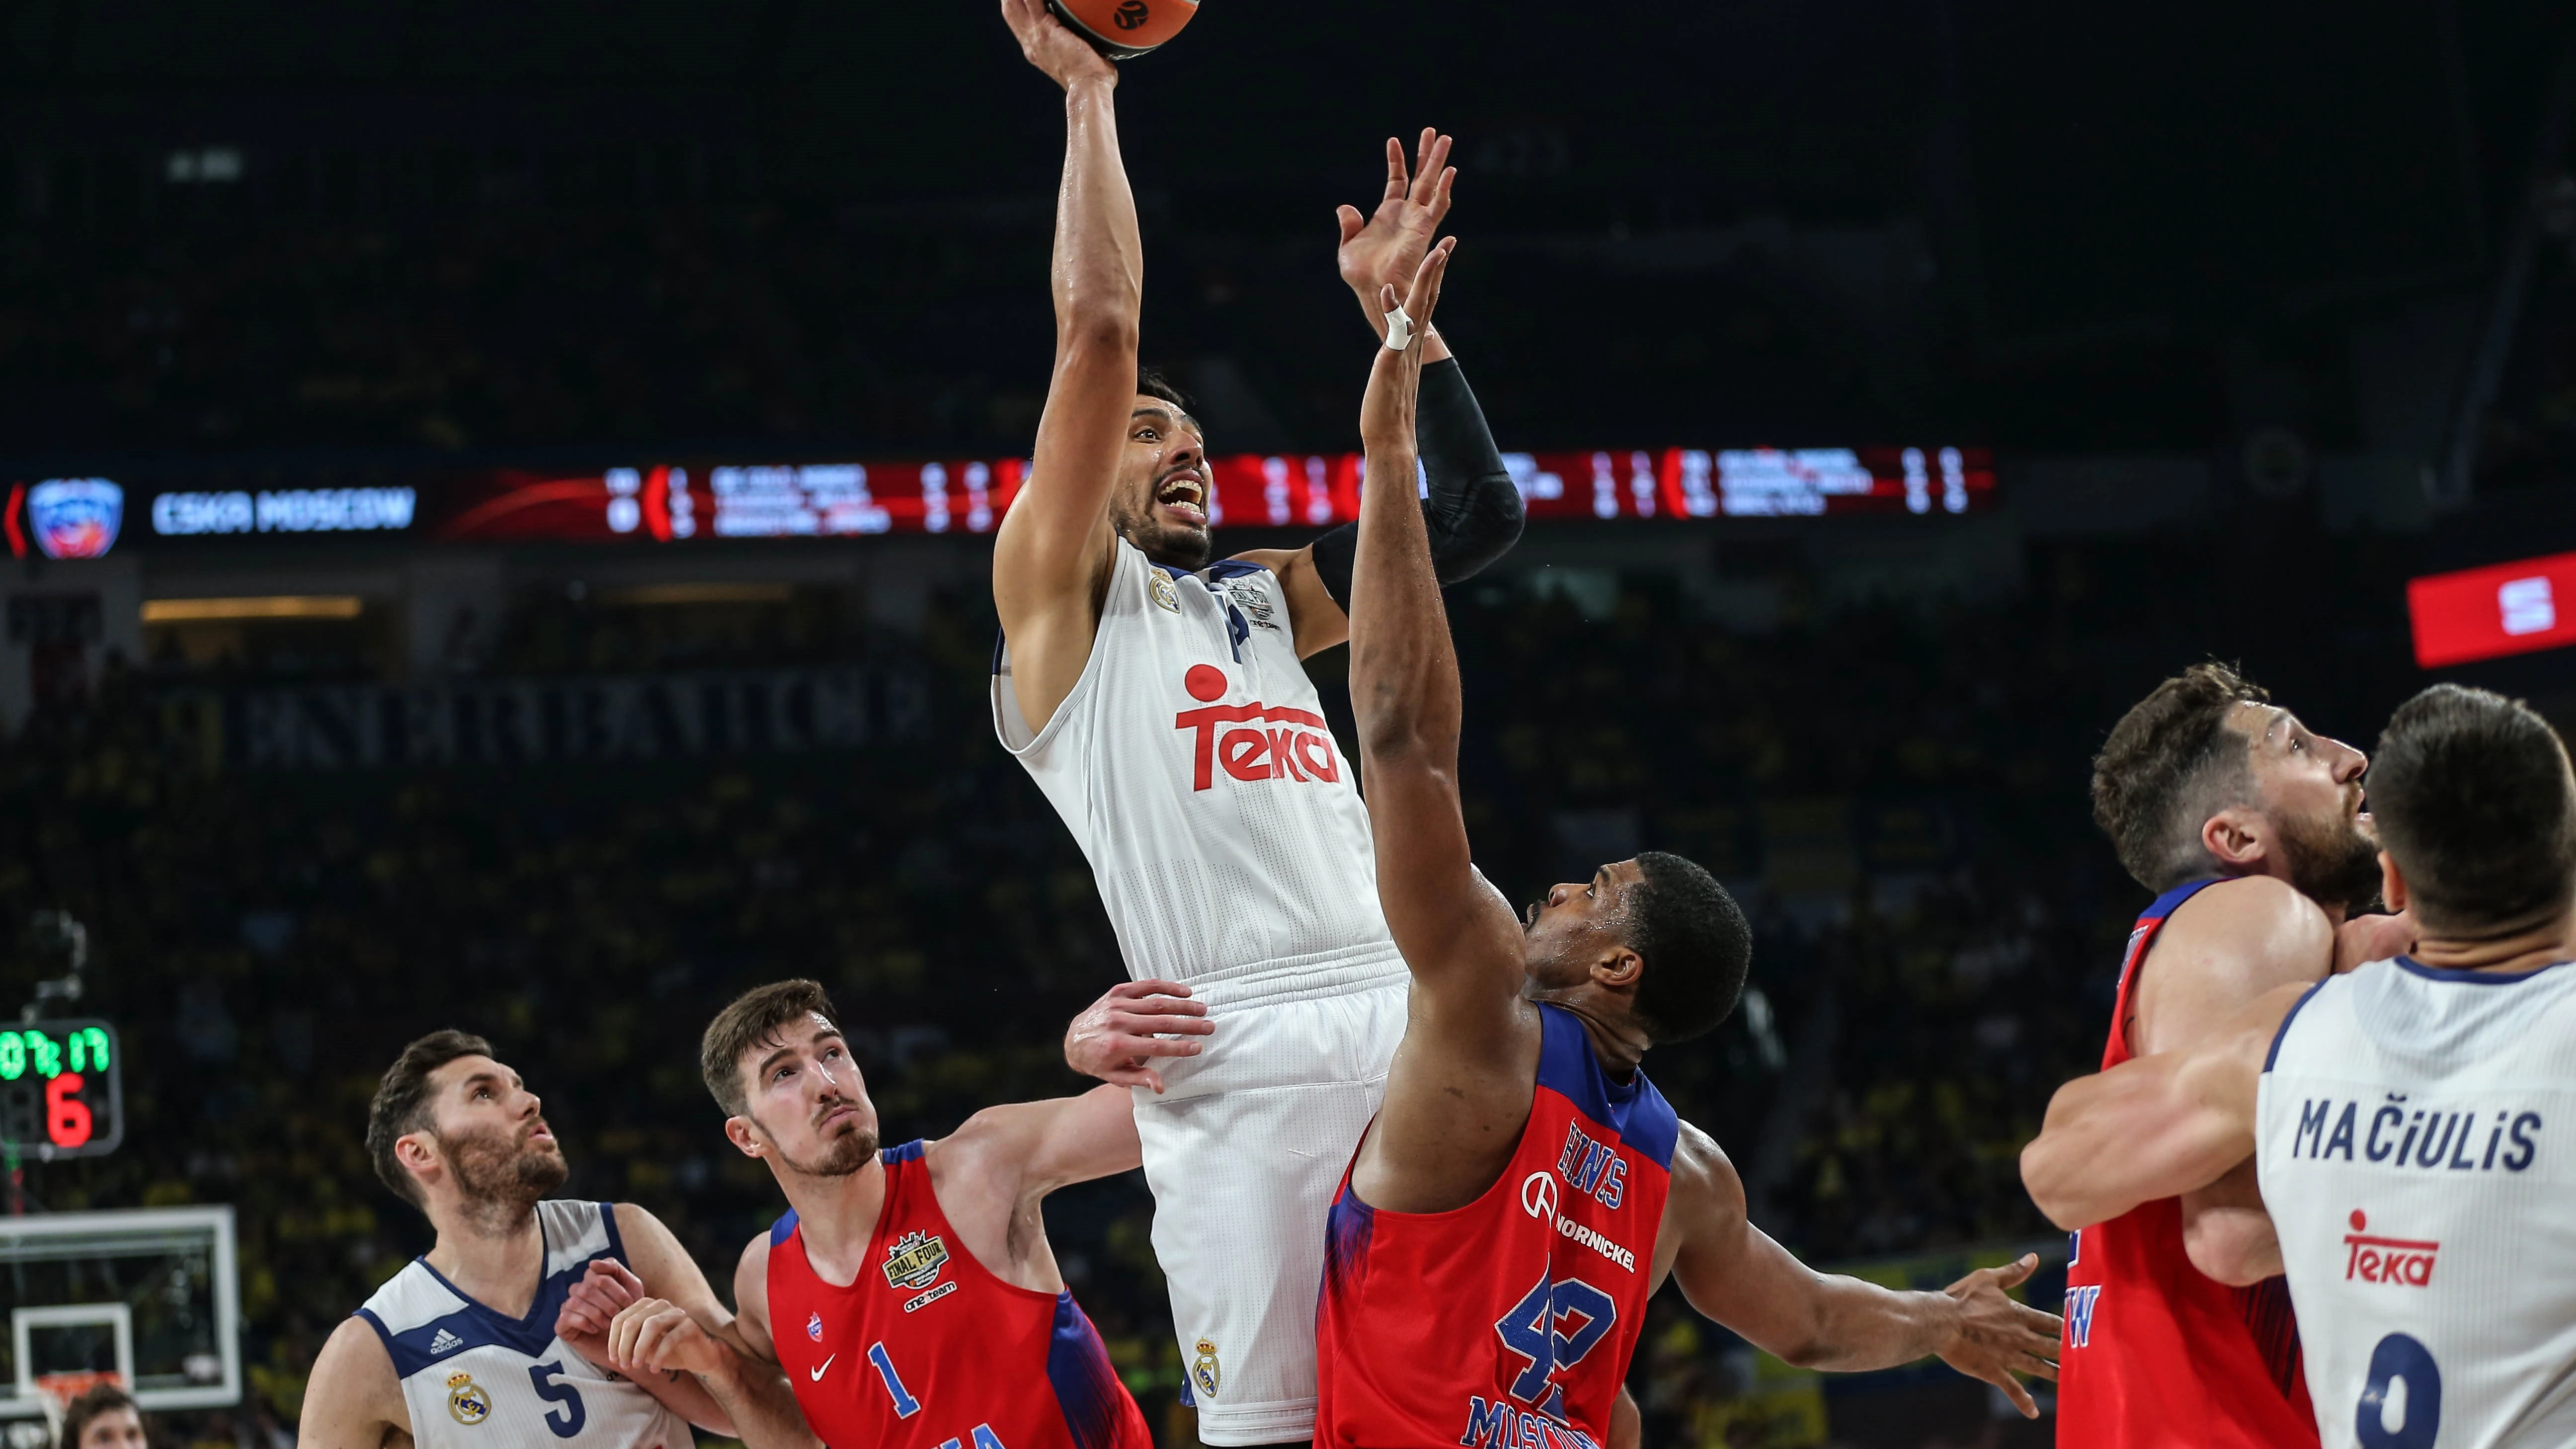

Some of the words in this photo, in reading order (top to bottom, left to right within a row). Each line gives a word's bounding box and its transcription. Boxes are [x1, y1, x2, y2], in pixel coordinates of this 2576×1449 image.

[256, 486, 416, 532] MOSCOW
[1176, 702, 1340, 792] Teka
[46, 1072, 92, 1148] 6
[887, 1257, 916, 1278] FINAL
[914, 1242, 942, 1265] FOUR
[1556, 1211, 1635, 1274] NORNICKEL
[2344, 1234, 2439, 1288] Teka
[430, 1337, 464, 1355] adidas
[529, 1360, 586, 1438] 5
[868, 1340, 921, 1420] 1
